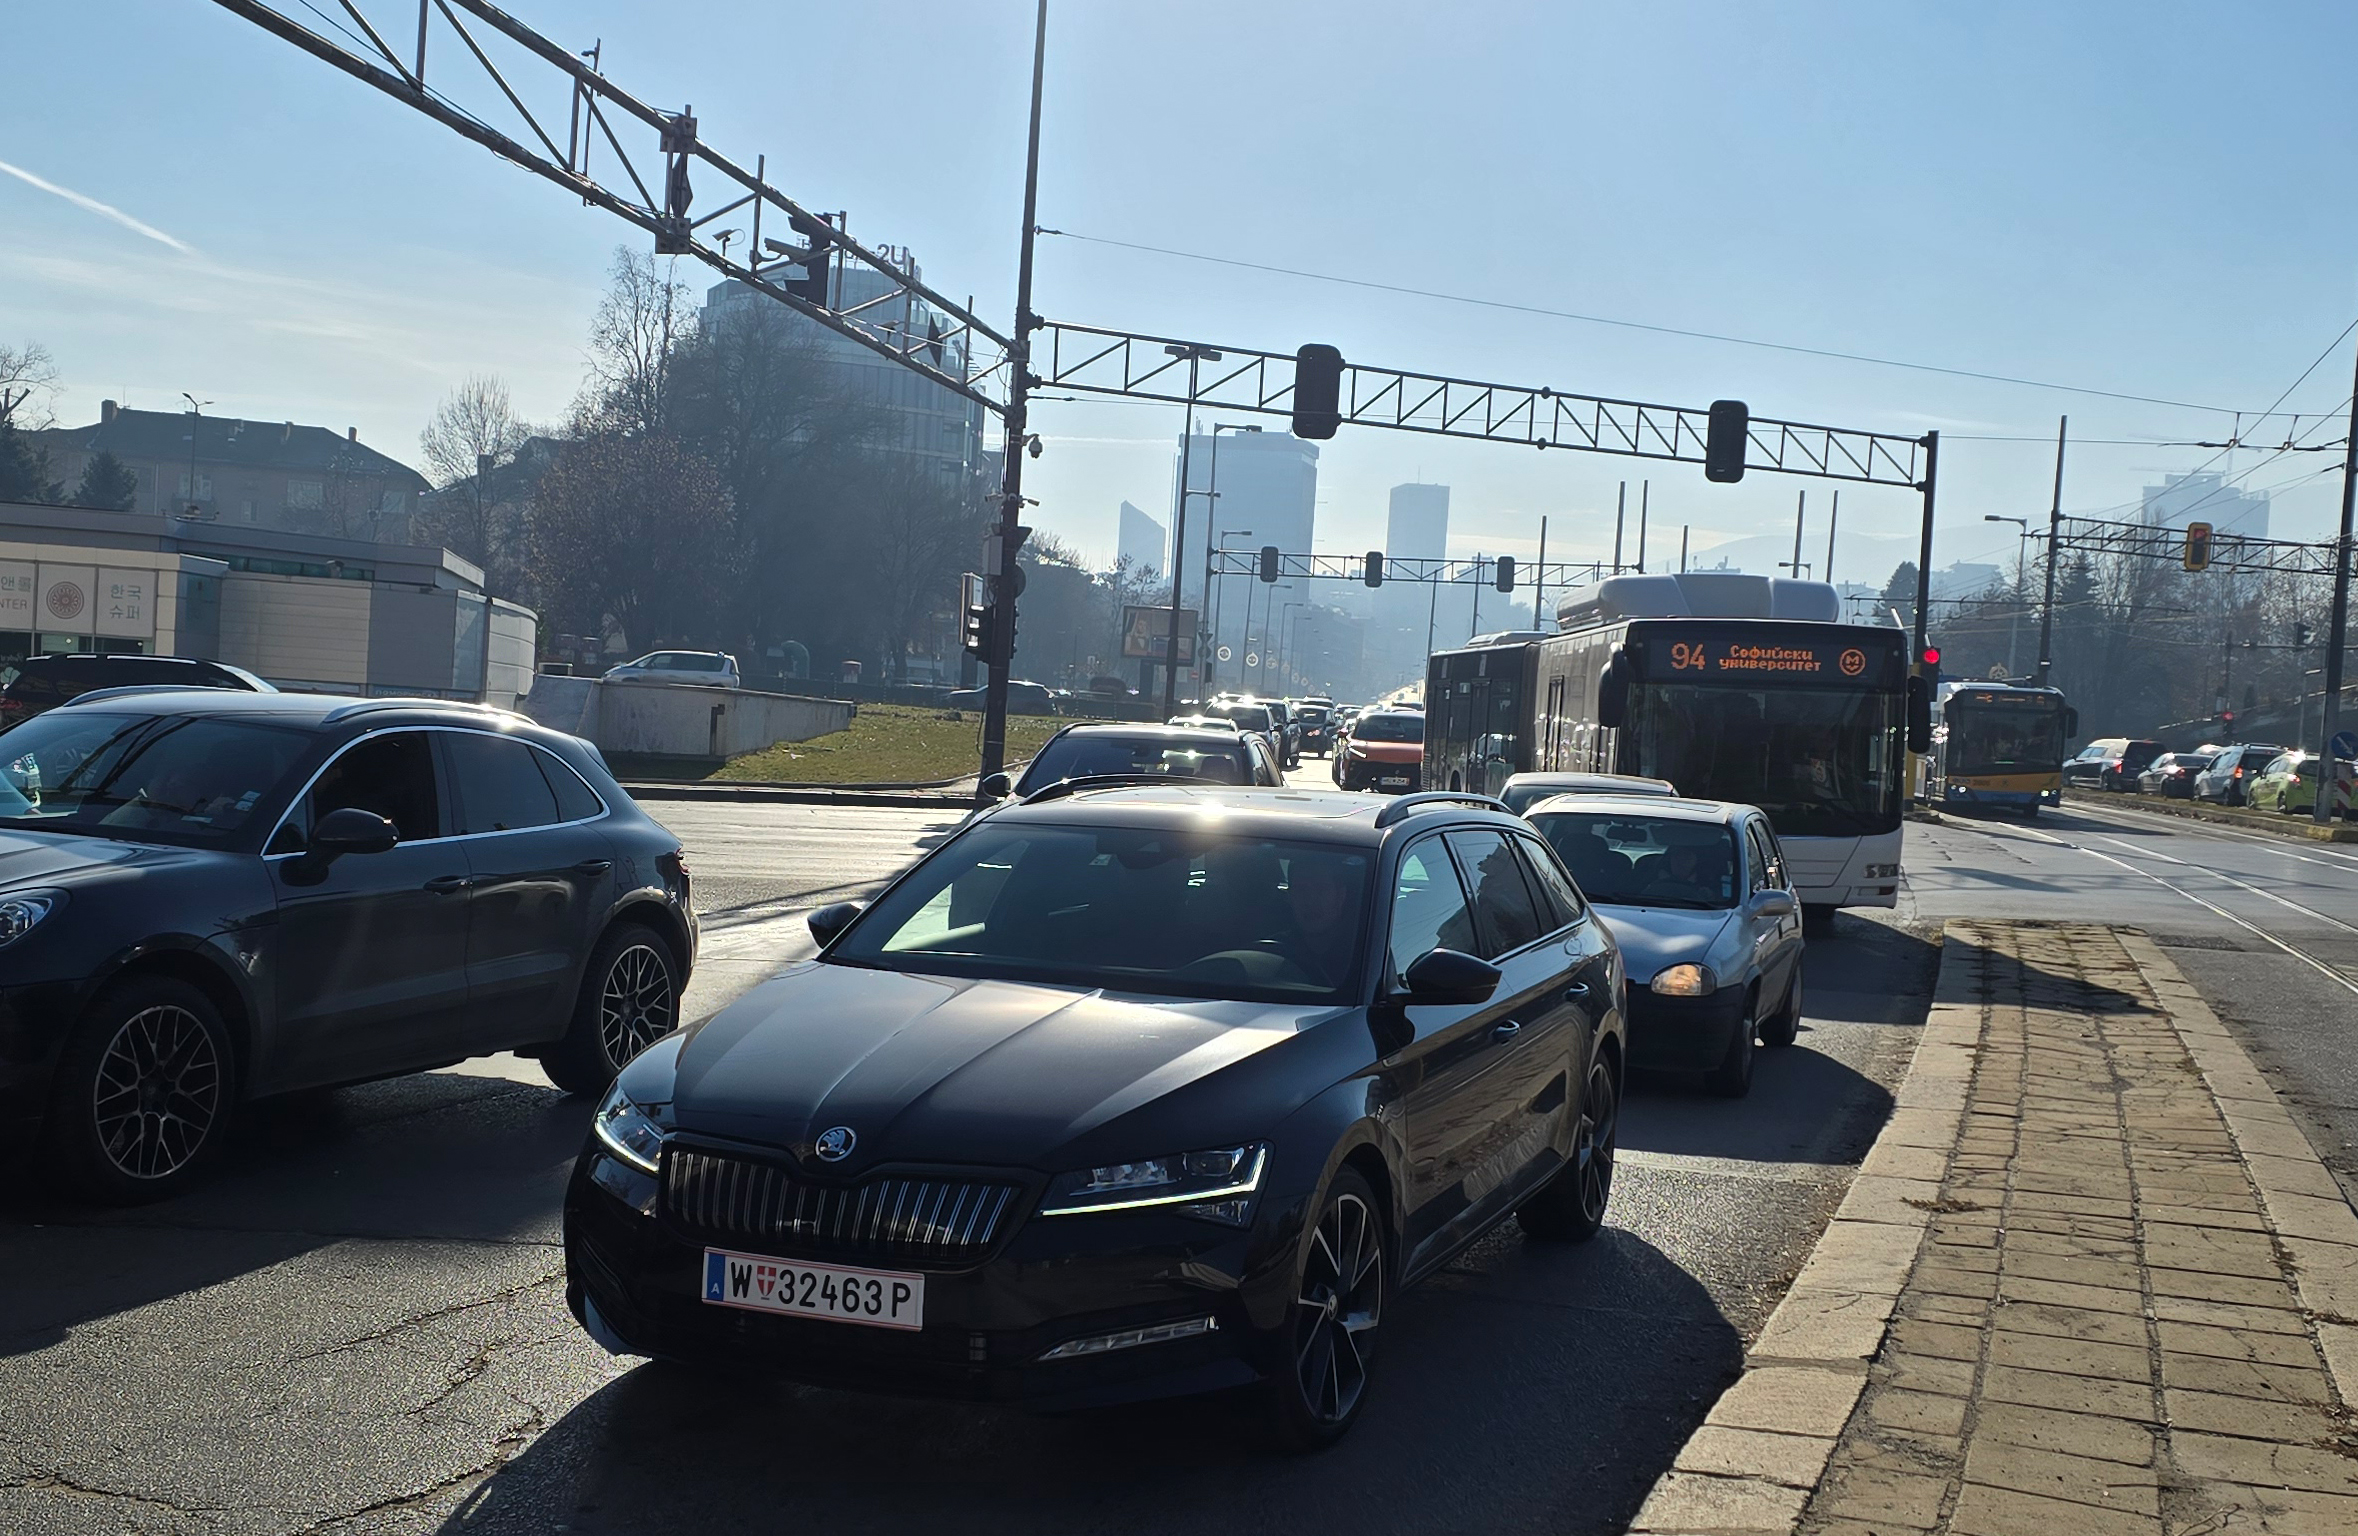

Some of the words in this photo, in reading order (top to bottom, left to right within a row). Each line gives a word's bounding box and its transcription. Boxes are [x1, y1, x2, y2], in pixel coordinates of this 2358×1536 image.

[110, 584, 142, 600] 한국
[110, 604, 140, 620] 슈퍼
[1671, 643, 1706, 670] 94
[1730, 645, 1812, 661] Софийски
[1719, 658, 1822, 671] университет
[710, 1282, 720, 1294] A
[731, 1262, 752, 1298] W
